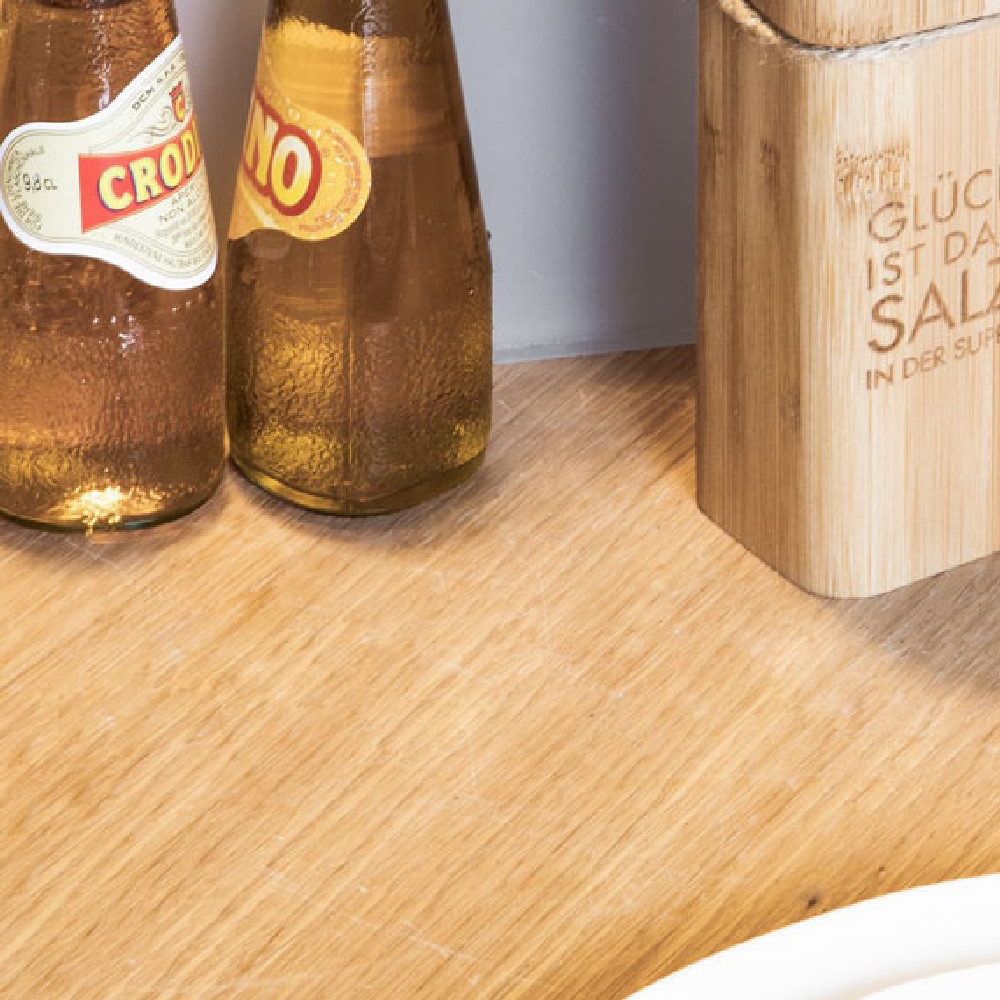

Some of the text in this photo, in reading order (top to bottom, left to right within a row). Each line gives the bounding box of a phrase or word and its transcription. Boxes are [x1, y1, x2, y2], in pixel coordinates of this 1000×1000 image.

[98, 126, 200, 212] CROD
[866, 243, 926, 291] IST
[866, 363, 894, 391] IN
[901, 344, 945, 380] DER
